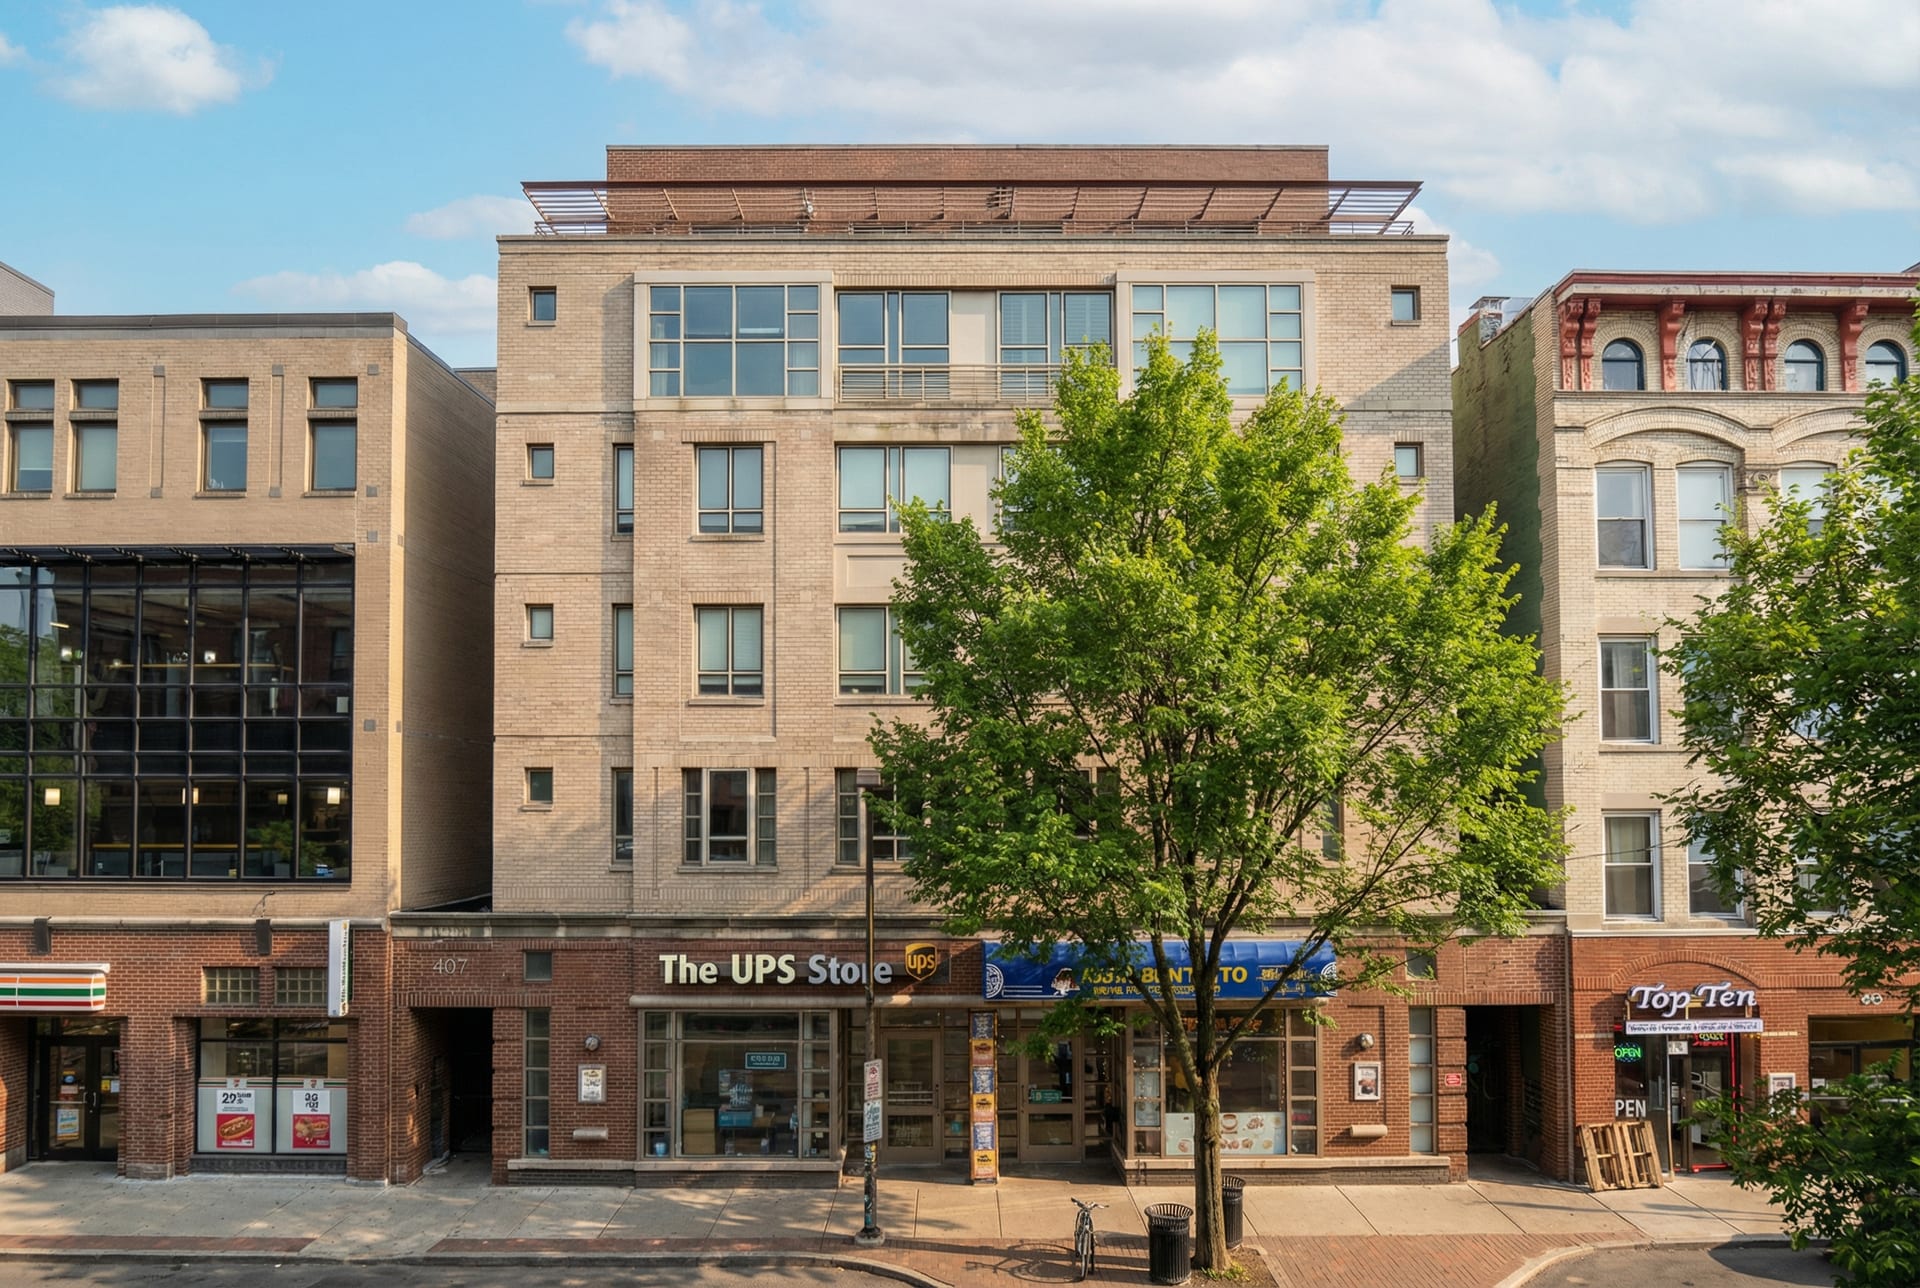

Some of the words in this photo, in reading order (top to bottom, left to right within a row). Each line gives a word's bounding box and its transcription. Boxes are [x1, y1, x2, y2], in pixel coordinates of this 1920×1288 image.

[432, 958, 469, 975] 407
[658, 954, 718, 984] The
[731, 954, 796, 985] UPS
[907, 952, 936, 974] ups
[1629, 983, 1691, 1018] Top
[1696, 981, 1758, 1007] Ten
[1614, 1047, 1642, 1058] OPEN
